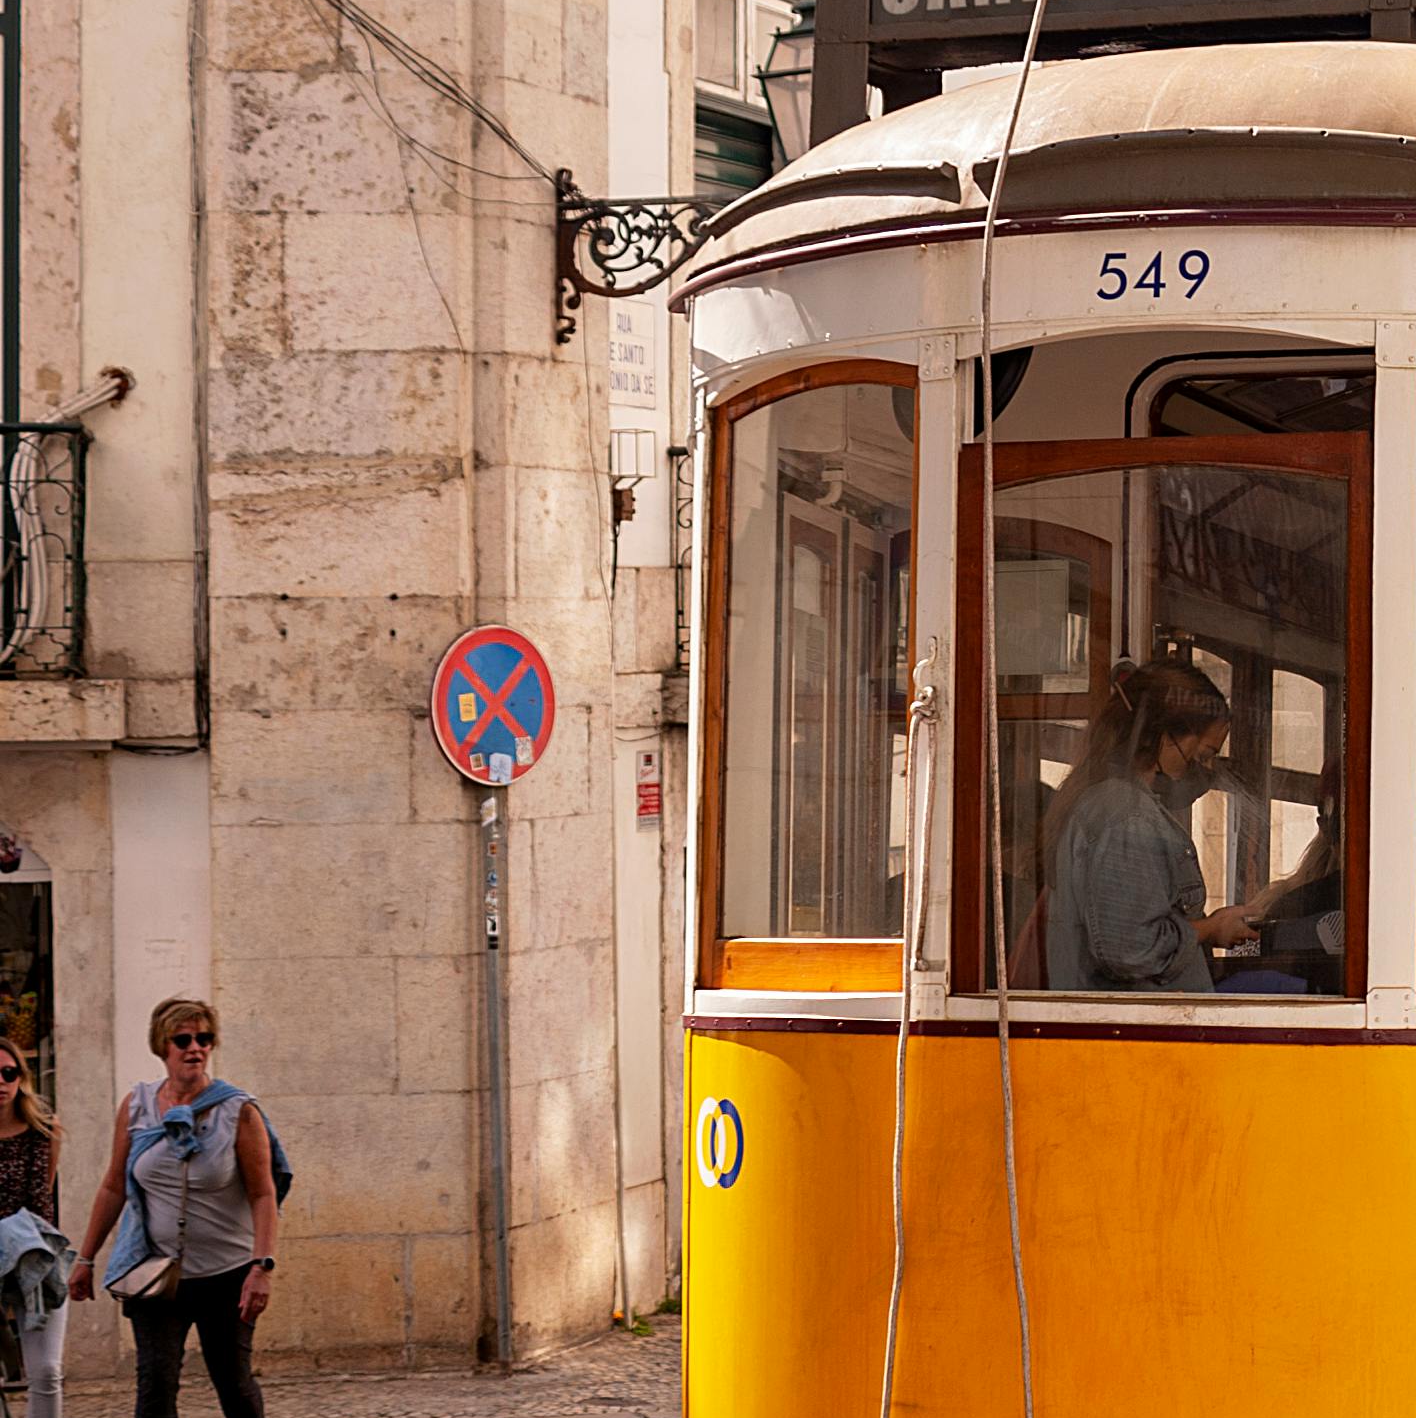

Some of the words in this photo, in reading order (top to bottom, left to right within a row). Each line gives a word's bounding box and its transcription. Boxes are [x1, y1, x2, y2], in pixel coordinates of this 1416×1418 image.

[1096, 249, 1212, 301] 549
[616, 312, 632, 333] RUA
[609, 341, 615, 361] E
[617, 342, 645, 365] SANTO
